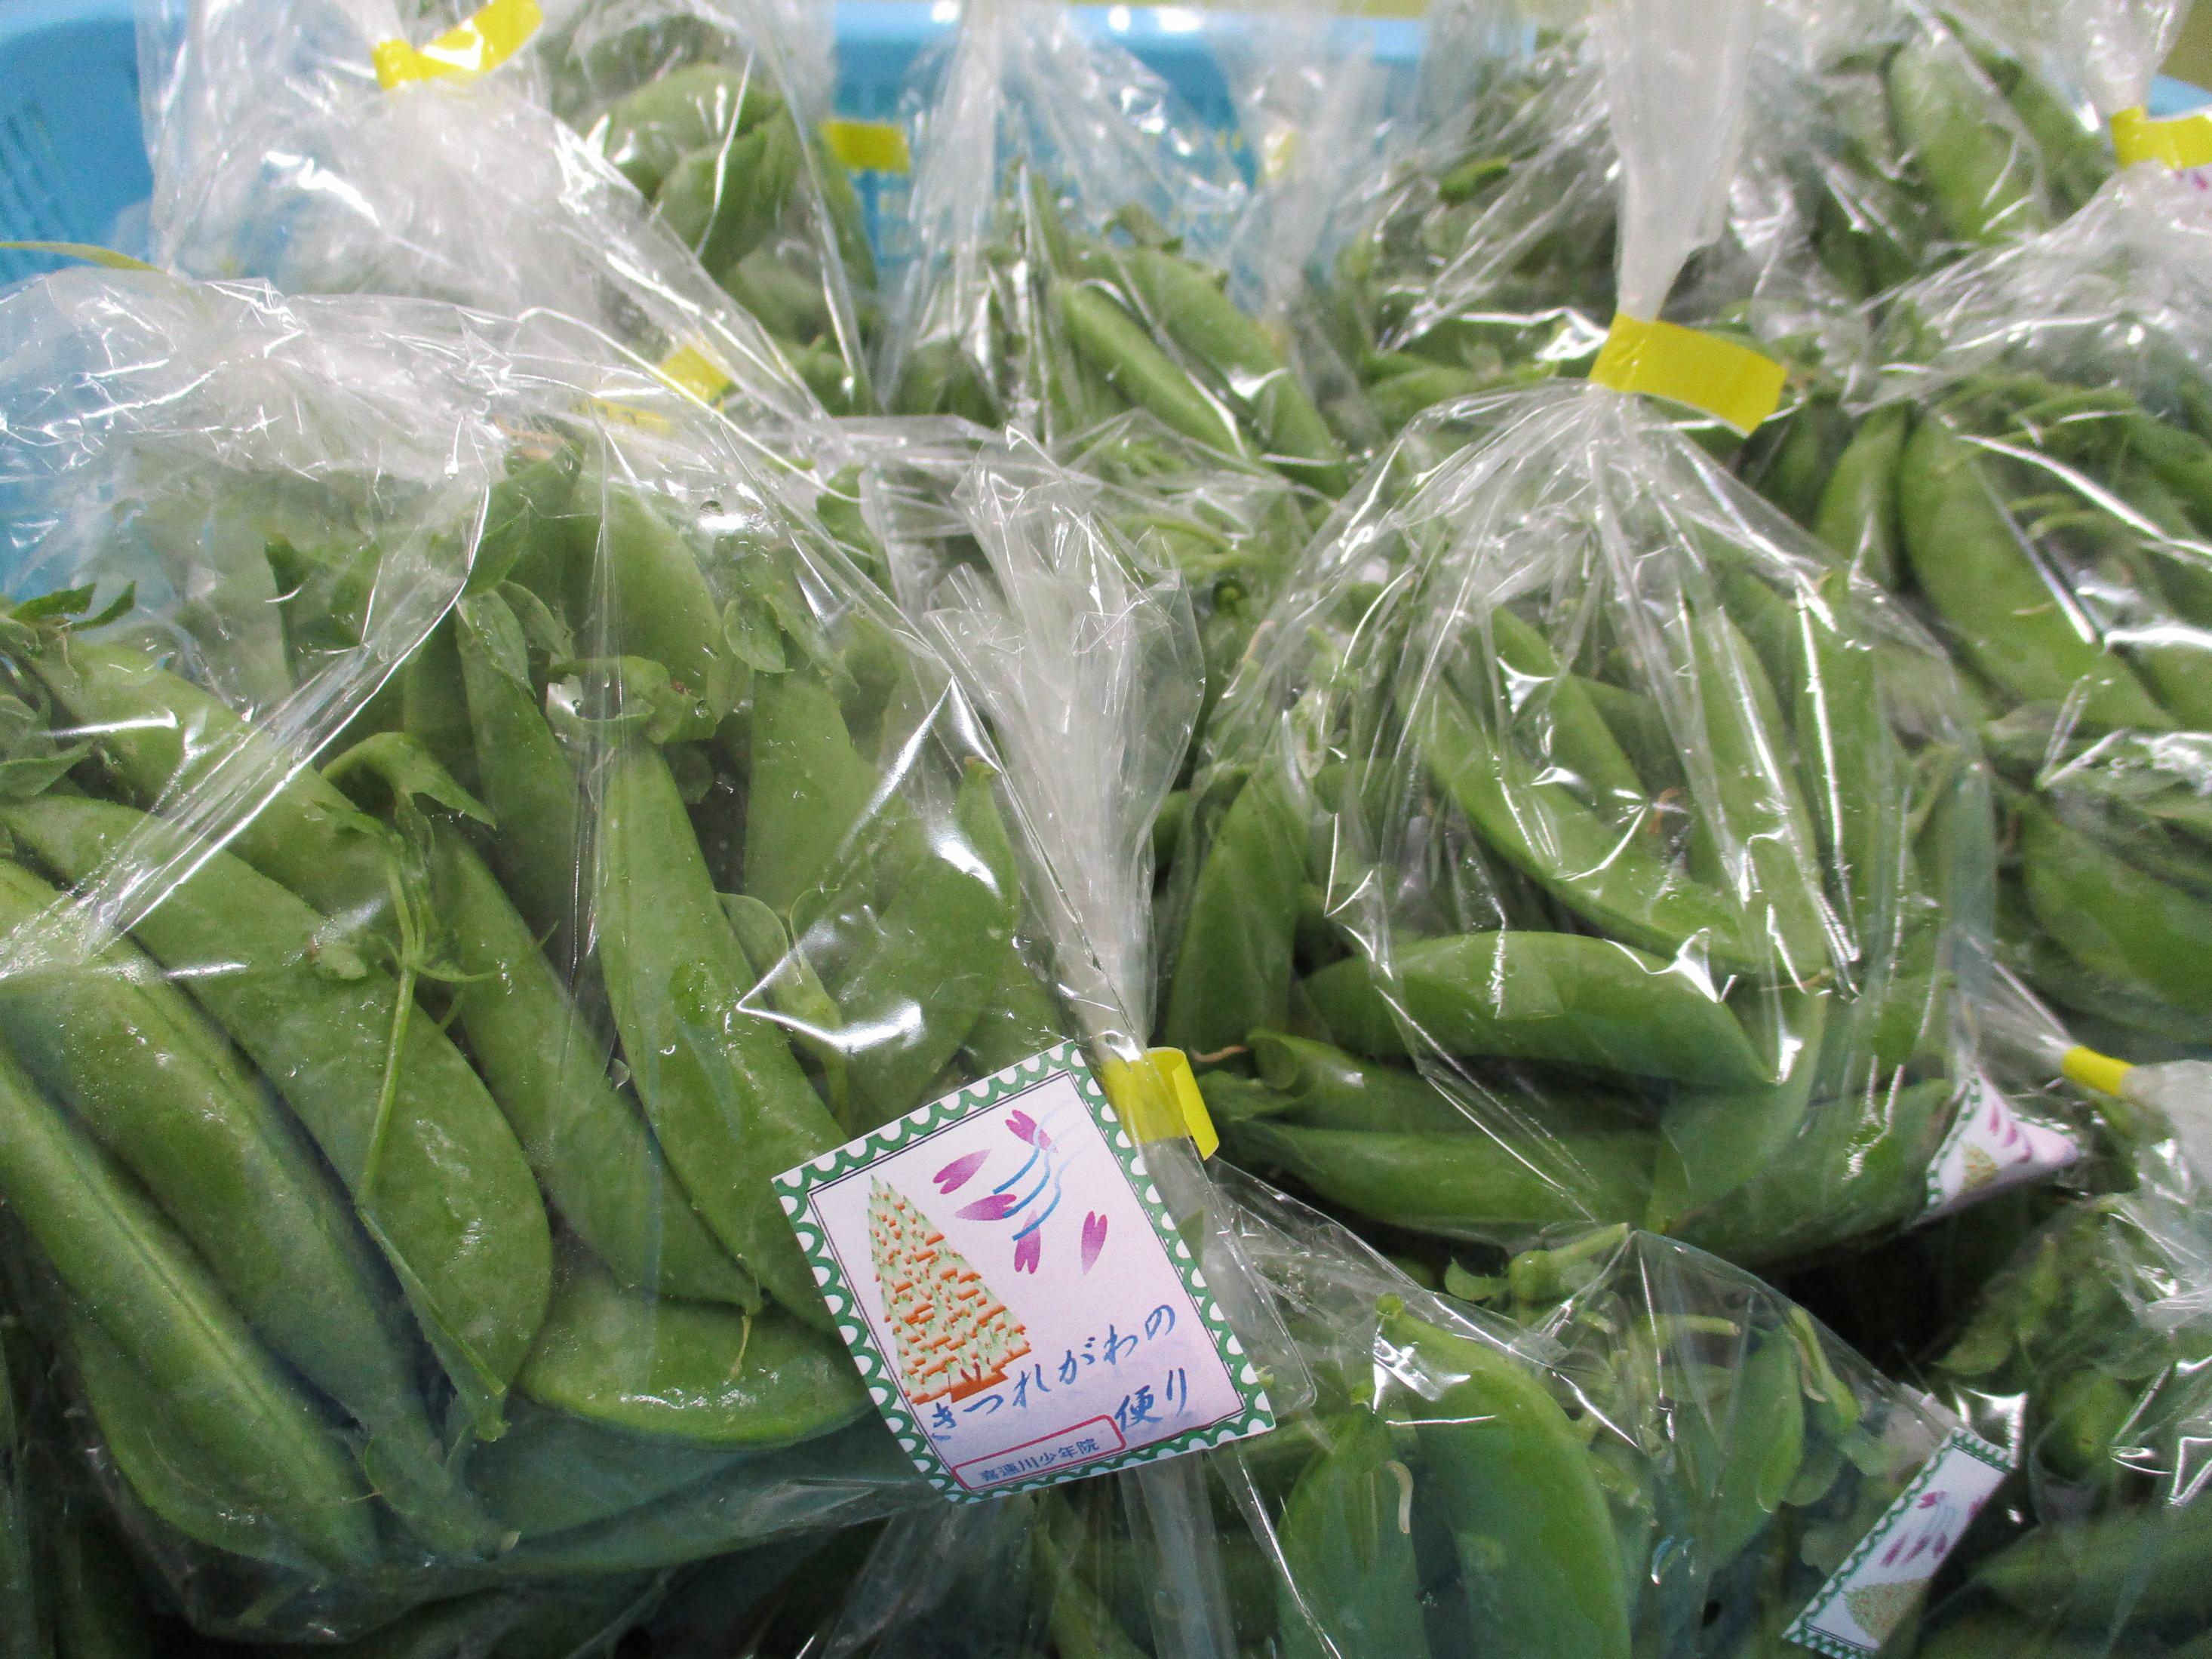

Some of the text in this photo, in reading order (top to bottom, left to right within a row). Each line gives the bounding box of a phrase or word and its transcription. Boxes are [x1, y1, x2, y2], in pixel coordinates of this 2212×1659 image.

[932, 1304, 1175, 1440] きつれがわの
[1115, 1368, 1187, 1433] 便り
